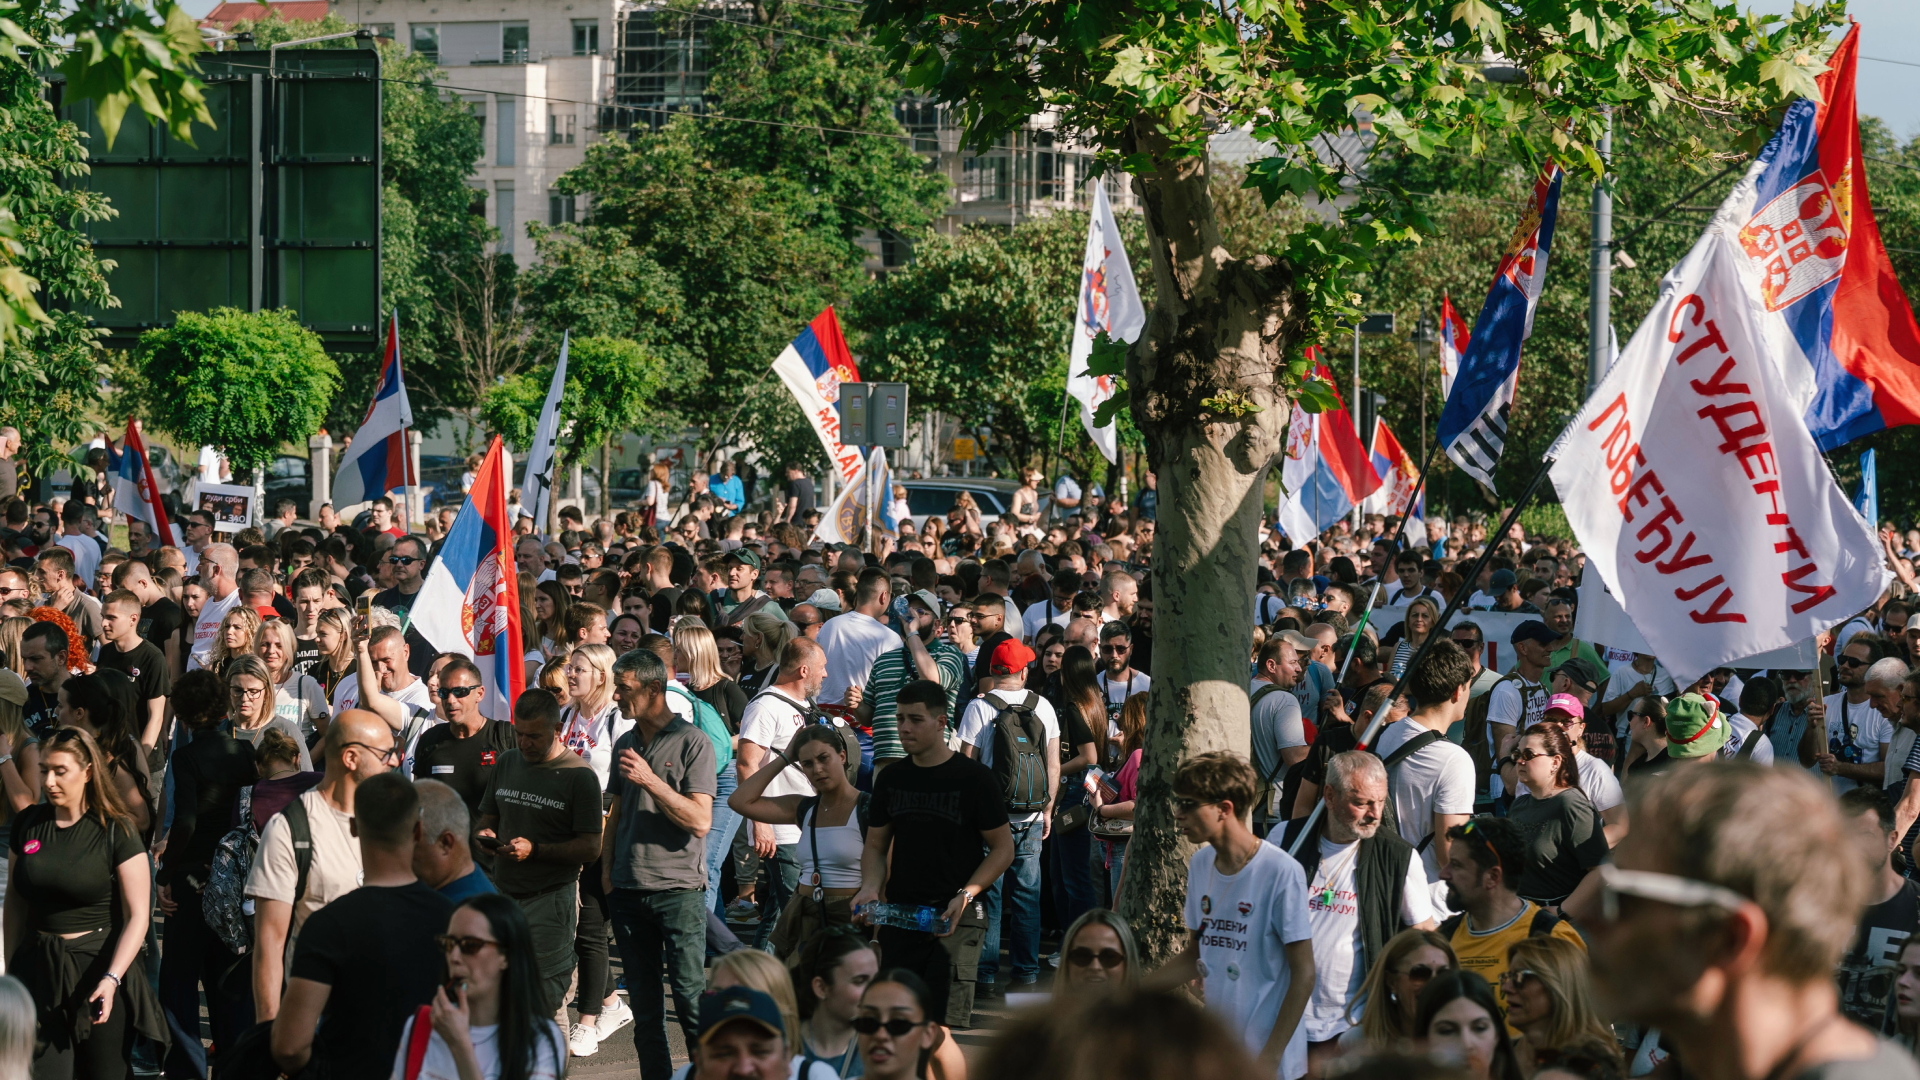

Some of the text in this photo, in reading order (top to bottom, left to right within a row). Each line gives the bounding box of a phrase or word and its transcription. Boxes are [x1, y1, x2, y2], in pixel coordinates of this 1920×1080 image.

[1588, 392, 1747, 623] ПОБЕЂУЈУ
[1668, 294, 1836, 614] СТУДЕНТИ
[495, 788, 565, 810] ARMANI EXCHANGE
